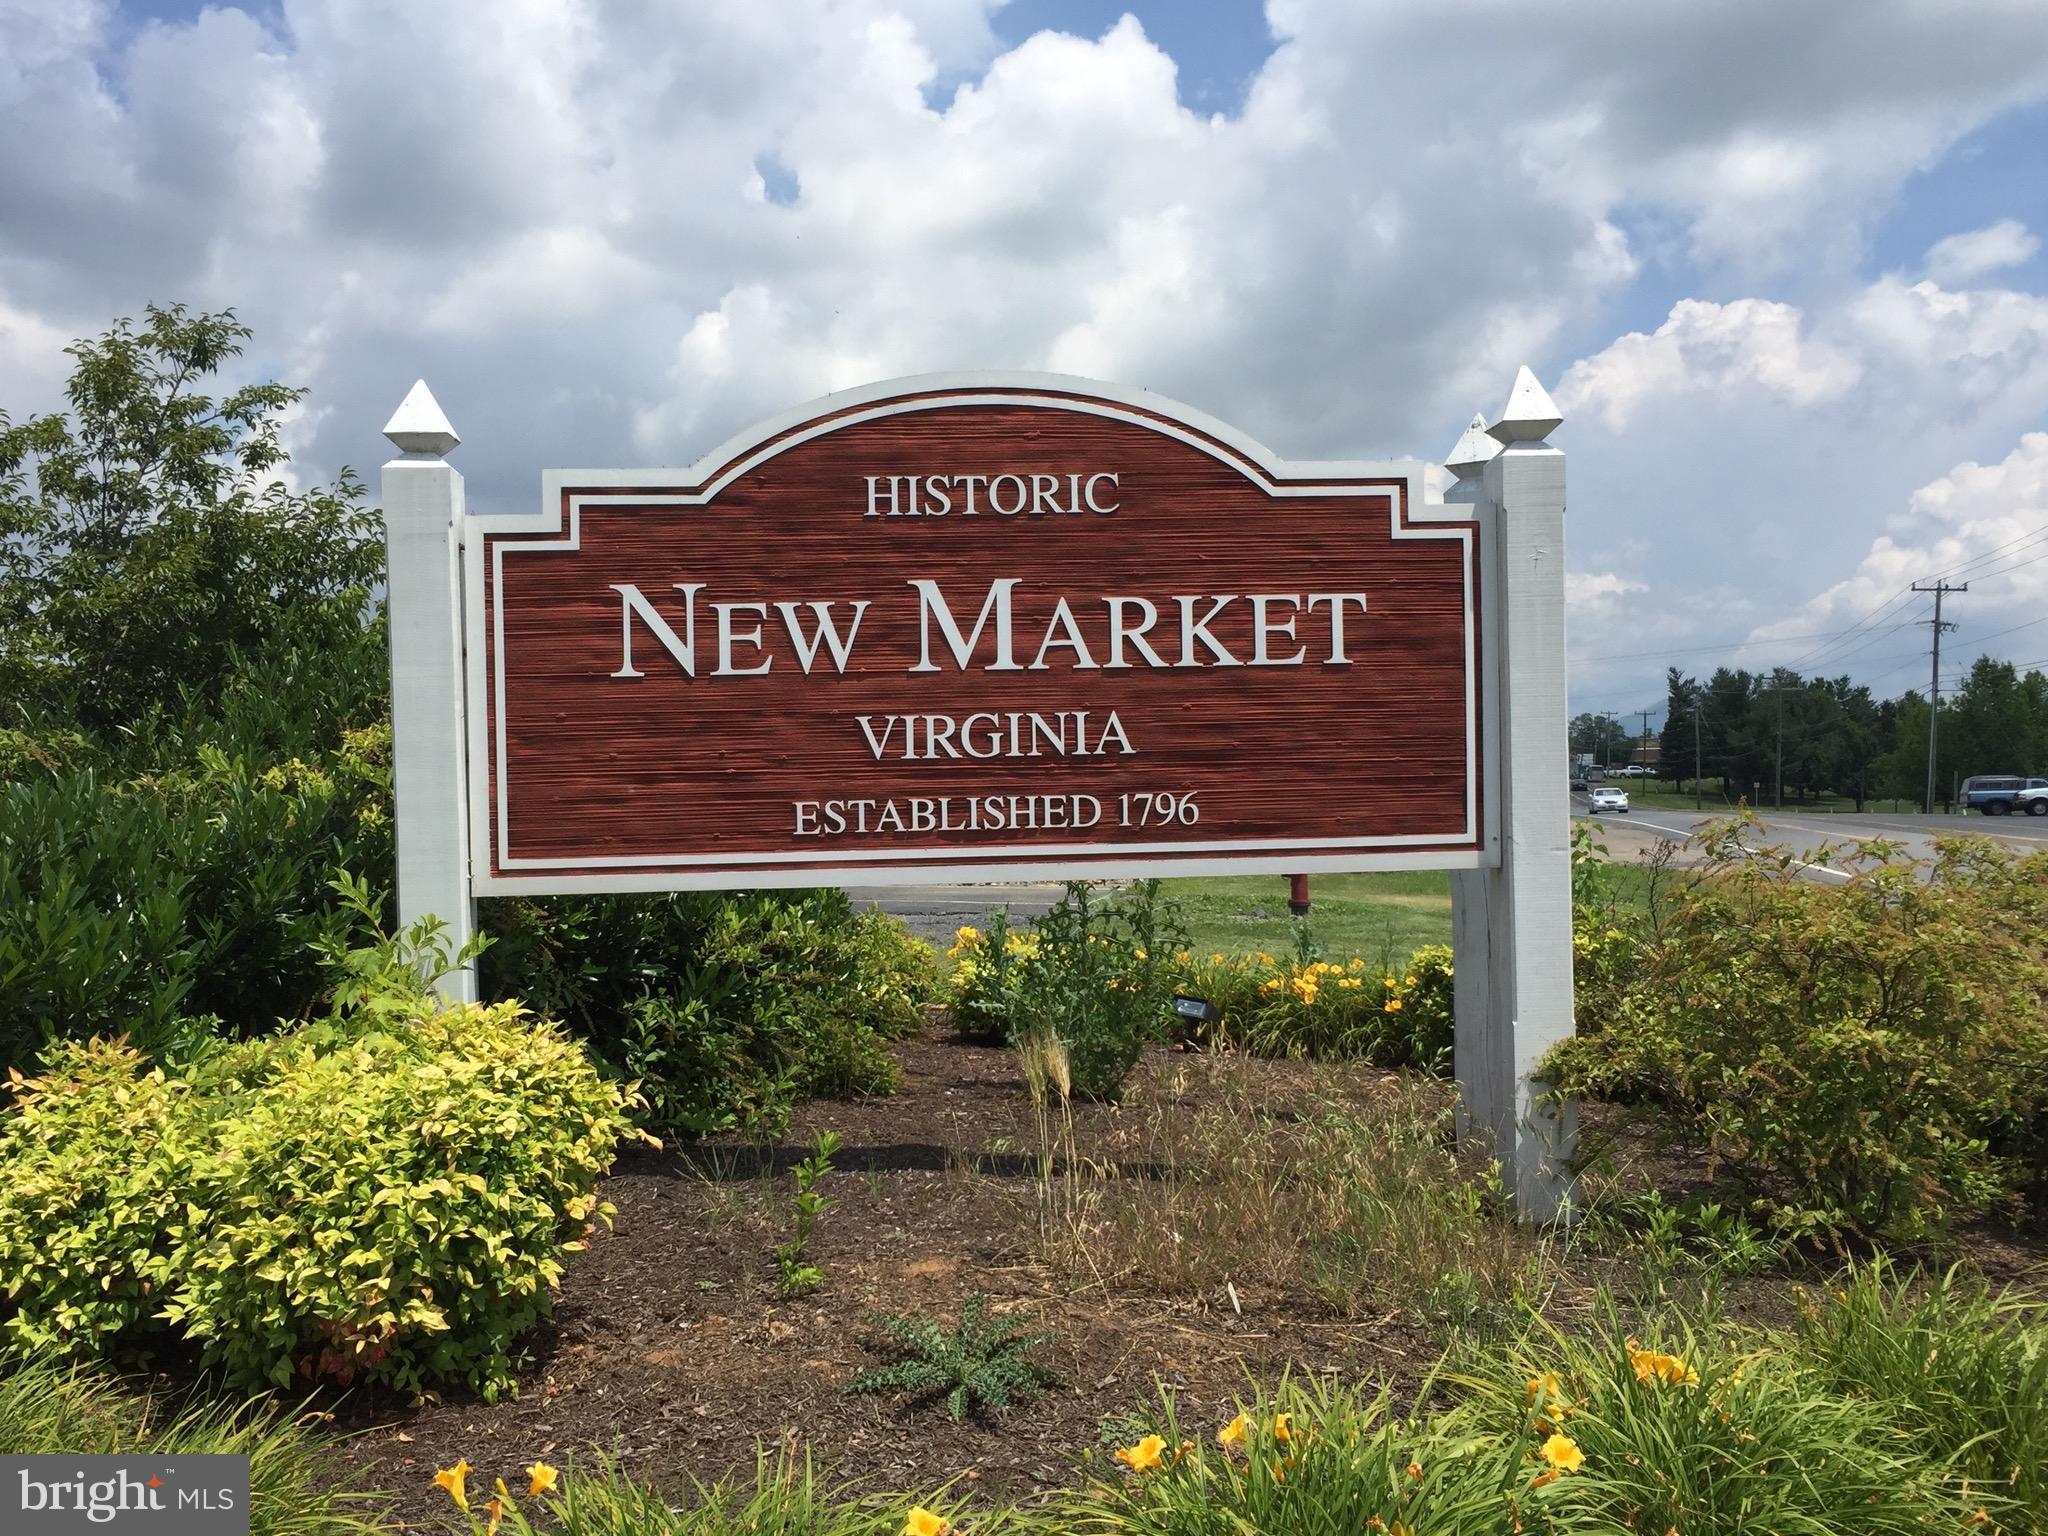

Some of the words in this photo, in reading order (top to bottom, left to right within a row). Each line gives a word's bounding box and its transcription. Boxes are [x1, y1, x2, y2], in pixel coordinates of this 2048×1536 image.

[864, 472, 1122, 517] HISTORIC
[609, 583, 871, 678] NEW
[907, 578, 1368, 673] MARKET
[855, 710, 1137, 761] VIRGINIA
[792, 794, 1103, 836] ESTABLISHED
[1118, 791, 1200, 828] 1796
